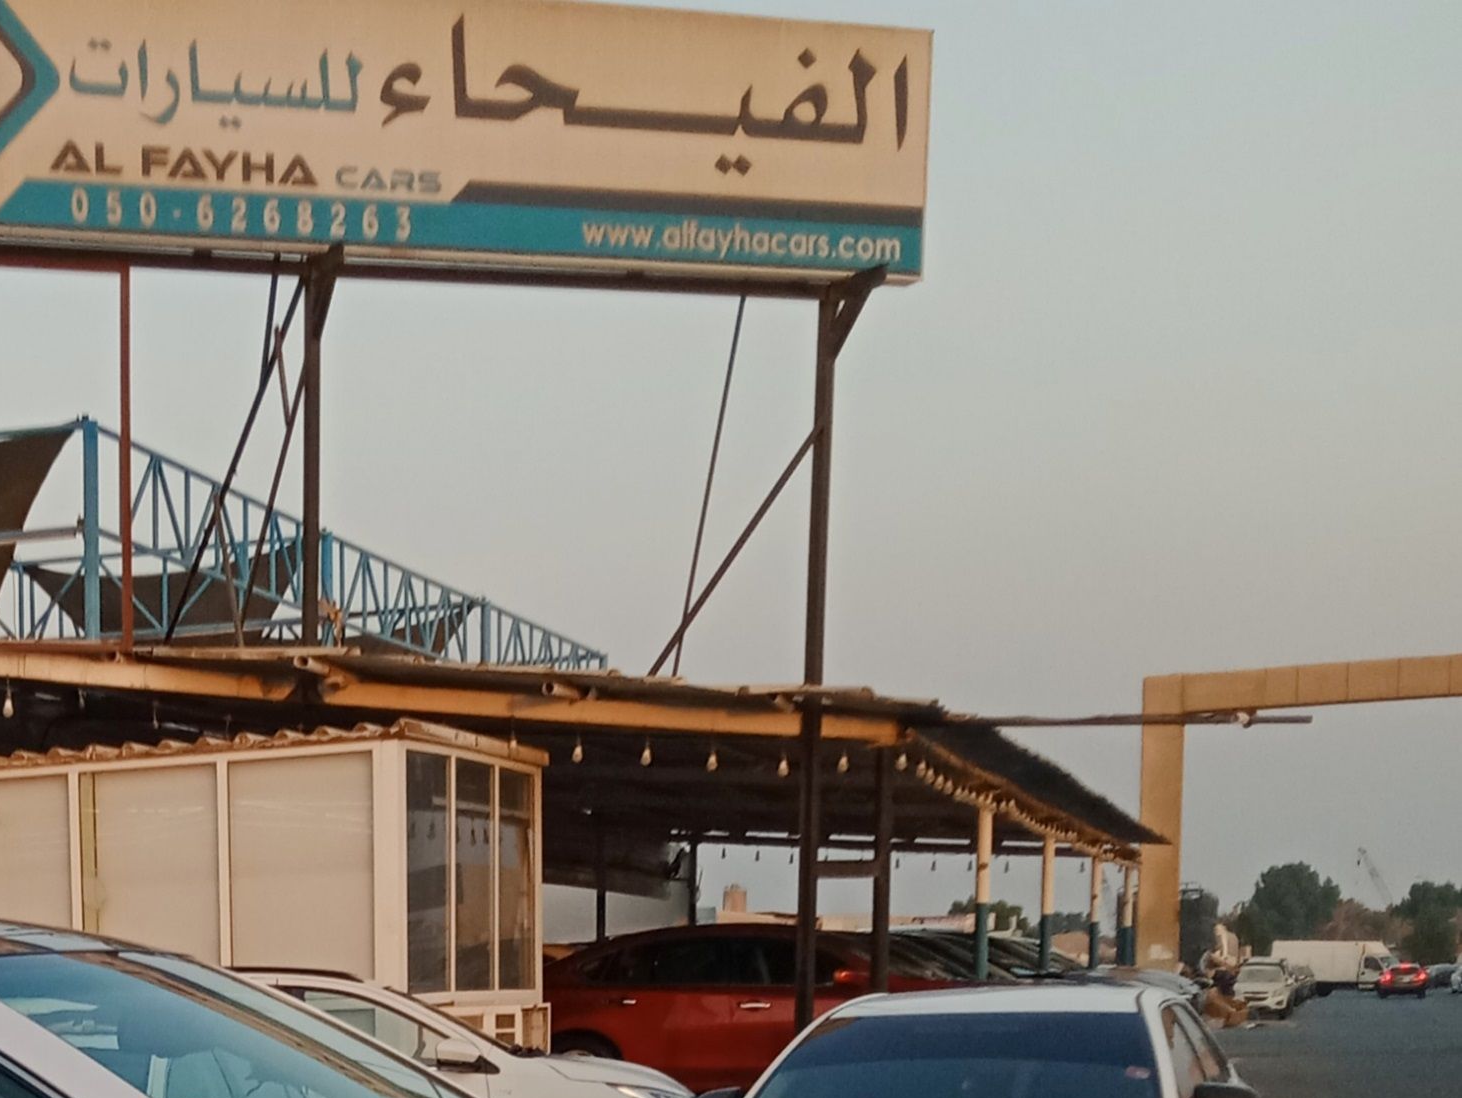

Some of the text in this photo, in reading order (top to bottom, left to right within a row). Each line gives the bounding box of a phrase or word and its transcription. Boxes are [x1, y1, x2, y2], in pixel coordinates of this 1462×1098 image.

[69, 12, 908, 176] الفيحاء للسيارات
[50, 140, 442, 193] AL FAYHA CARS
[583, 216, 901, 262] www.alfayhacars.com
